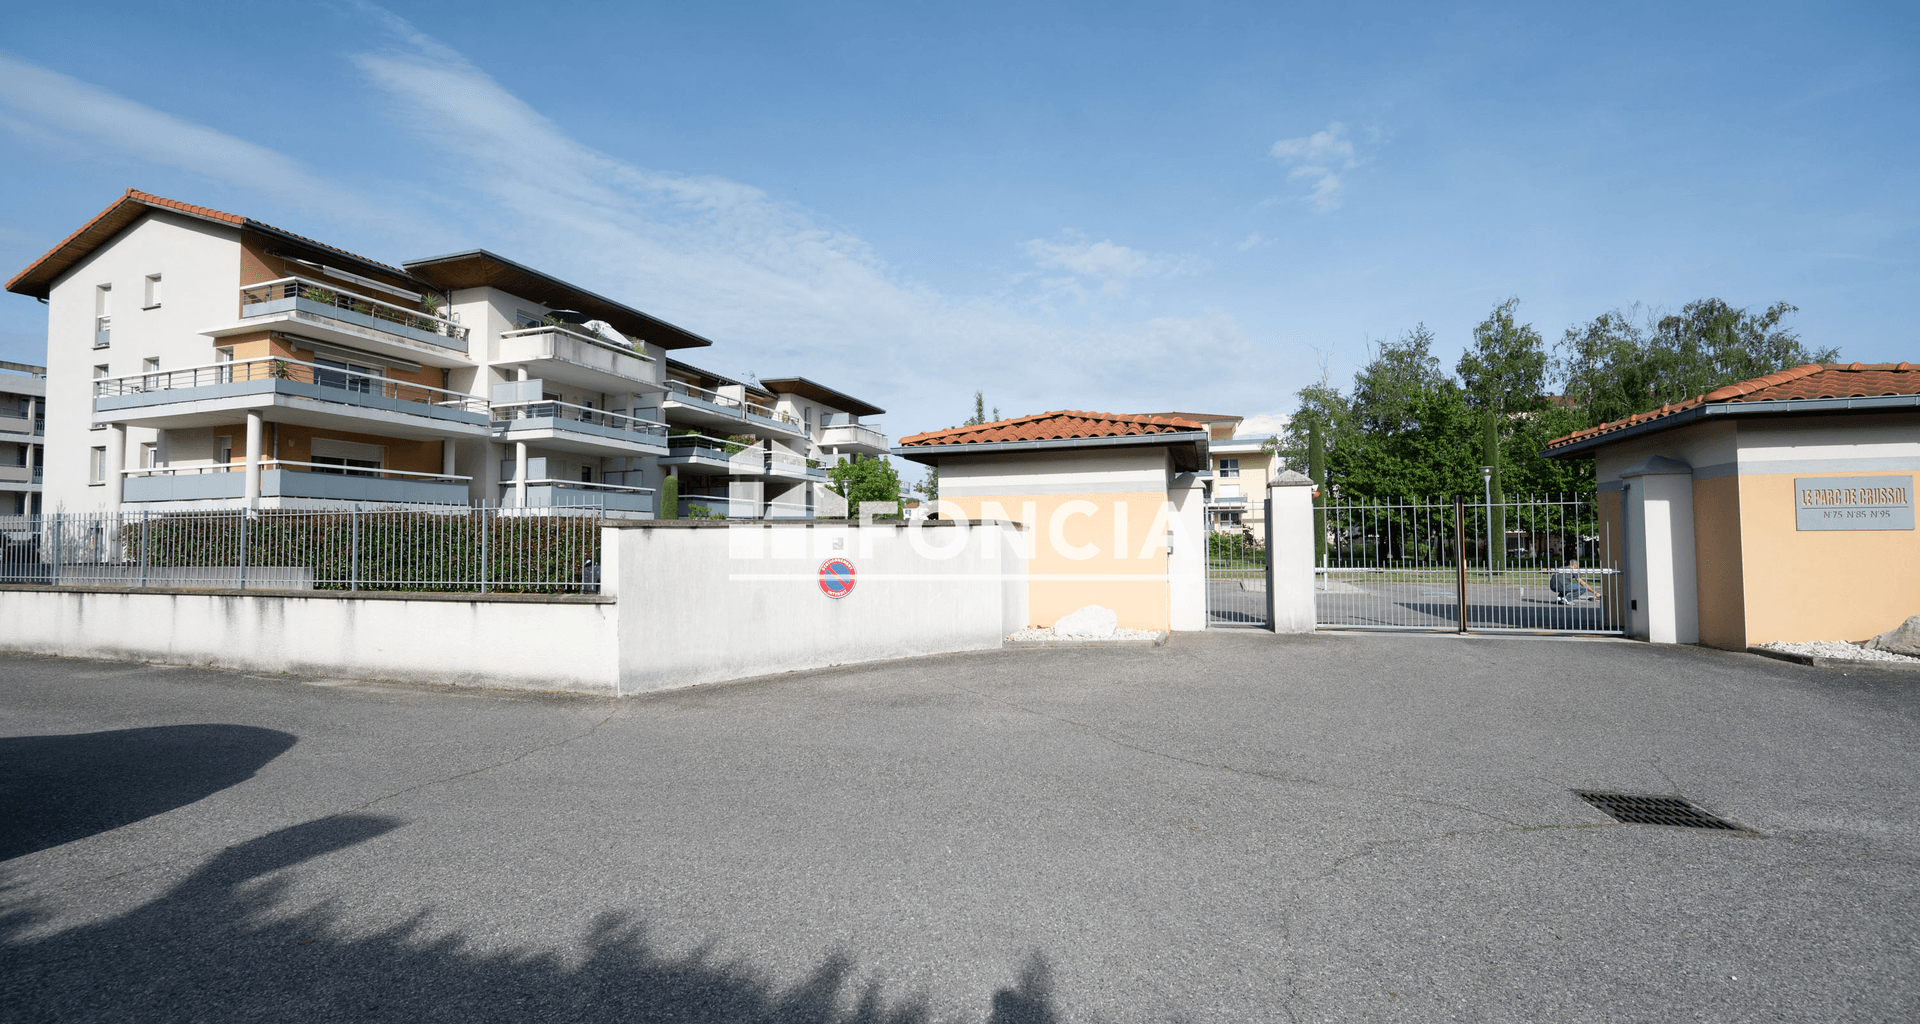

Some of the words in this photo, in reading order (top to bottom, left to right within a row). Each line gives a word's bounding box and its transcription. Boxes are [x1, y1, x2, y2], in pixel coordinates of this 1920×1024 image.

[1802, 489, 1812, 506] LE
[1814, 489, 1842, 506] PARC
[1844, 488, 1857, 505] DE
[1859, 487, 1908, 505] CRUSSOL
